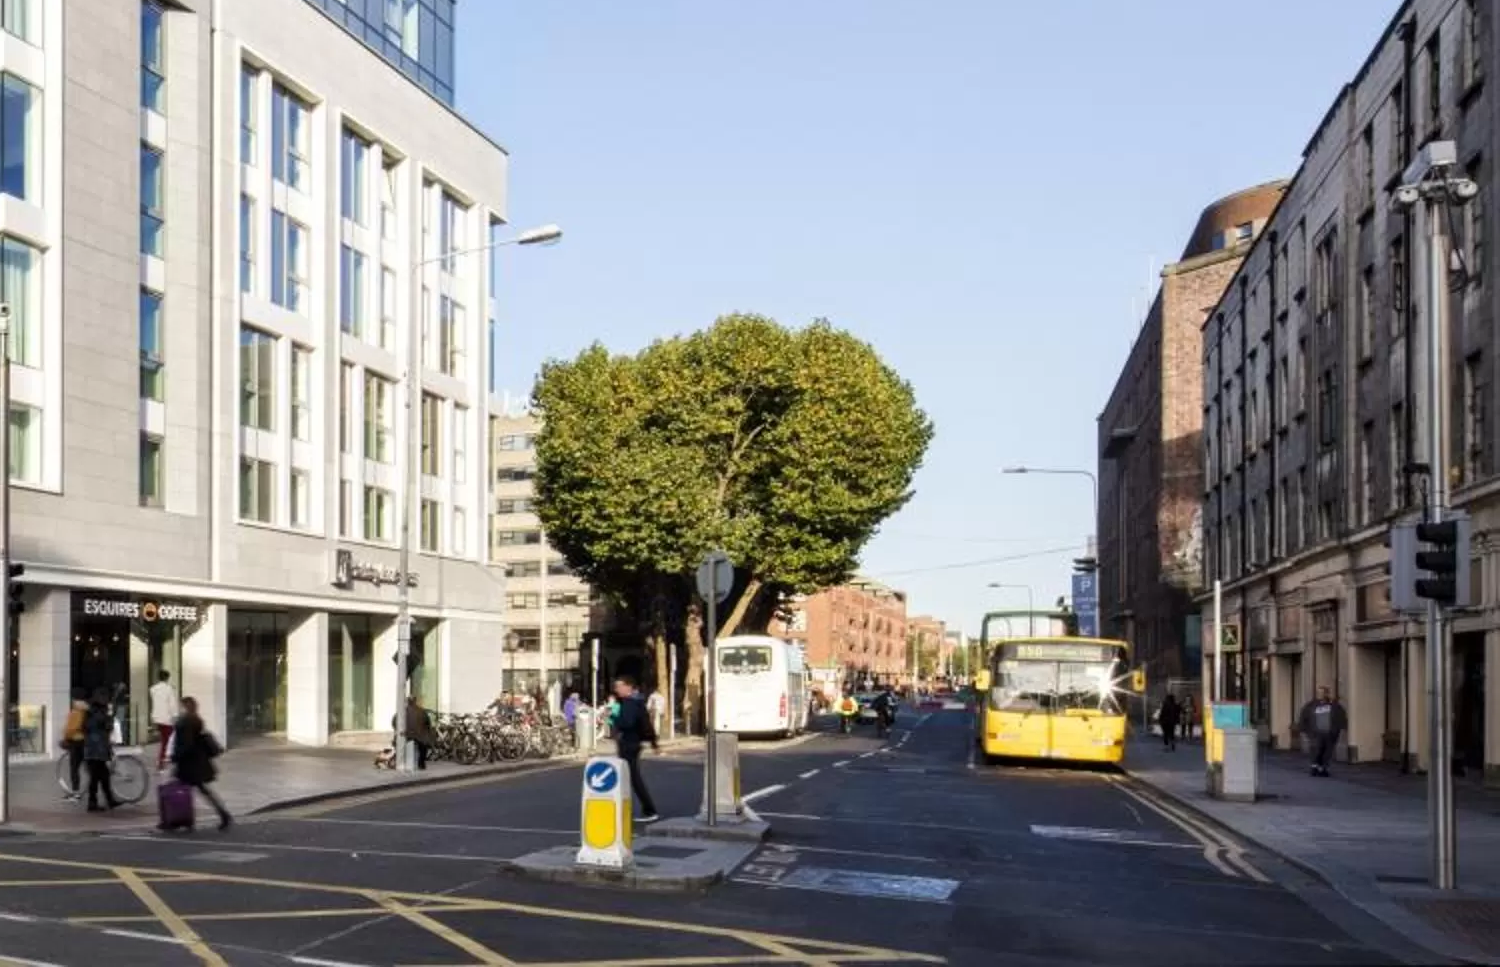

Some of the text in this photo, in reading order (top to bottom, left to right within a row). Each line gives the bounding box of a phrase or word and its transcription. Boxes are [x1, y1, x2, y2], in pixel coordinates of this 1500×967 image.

[1080, 580, 1091, 594] P
[84, 599, 197, 620] ESQUIRES COFFEE
